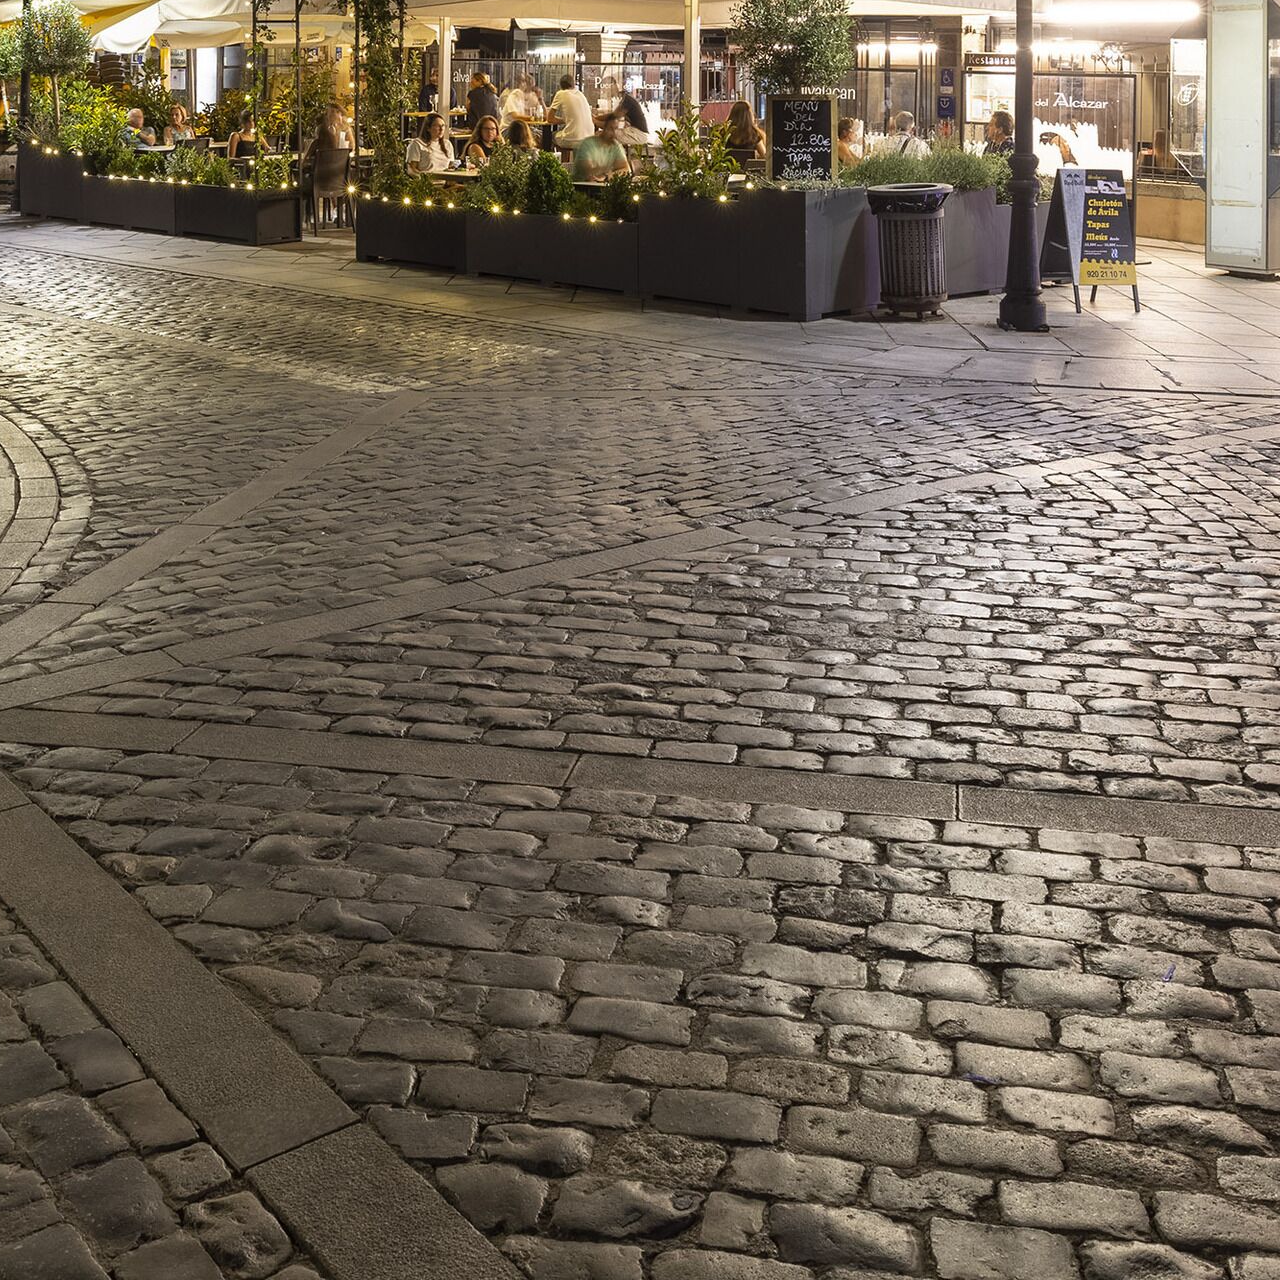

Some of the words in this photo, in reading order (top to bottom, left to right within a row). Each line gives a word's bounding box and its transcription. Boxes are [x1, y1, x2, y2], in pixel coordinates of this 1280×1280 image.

[968, 55, 1016, 65] Restauran
[1035, 98, 1048, 107] del
[1053, 92, 1108, 108] Alcazar
[793, 113, 815, 122] DEL
[1088, 199, 1123, 207] Chuletón
[1088, 208, 1097, 216] de
[1087, 221, 1110, 230] Tapas
[1087, 270, 1099, 278] 920
[1100, 270, 1108, 278] 21
[1110, 270, 1118, 278] 10
[1119, 270, 1127, 278] 74
